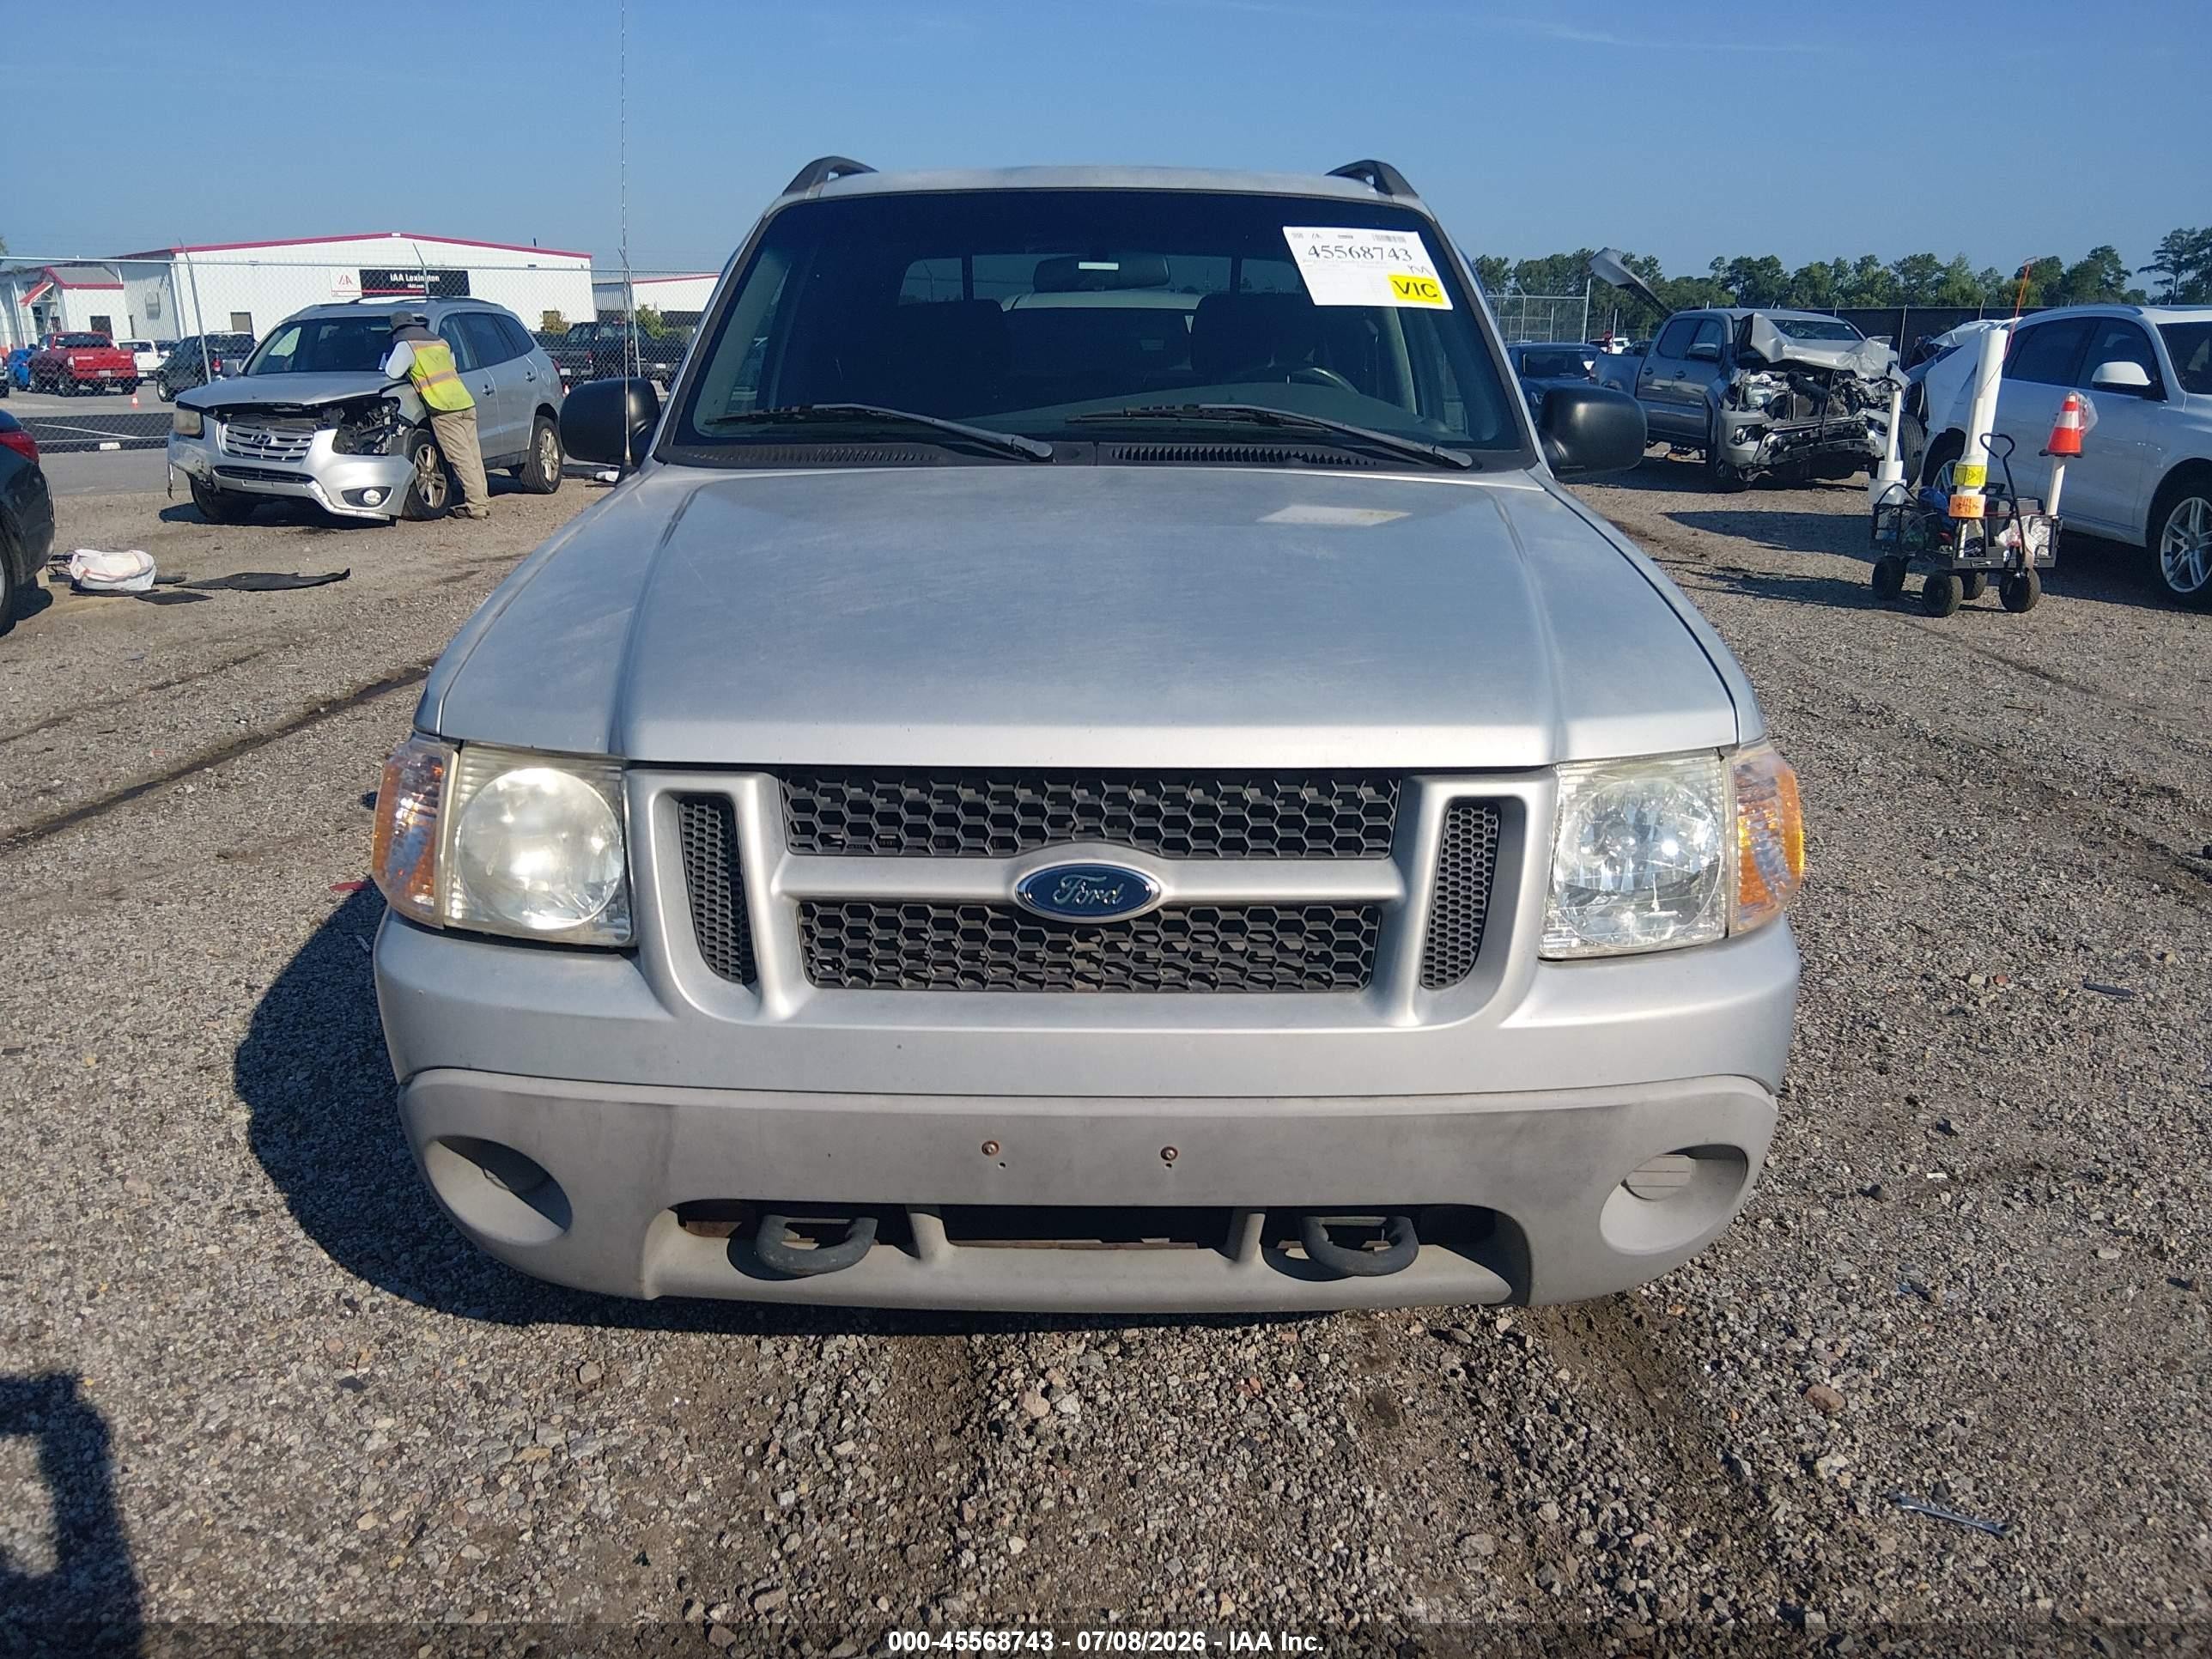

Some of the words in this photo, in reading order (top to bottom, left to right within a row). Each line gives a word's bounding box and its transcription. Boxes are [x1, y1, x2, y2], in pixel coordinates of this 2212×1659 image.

[1308, 244, 1413, 262] 45568743
[390, 273, 404, 282] IAA
[1393, 280, 1437, 298] VIC
[1052, 874, 1125, 905] Ford
